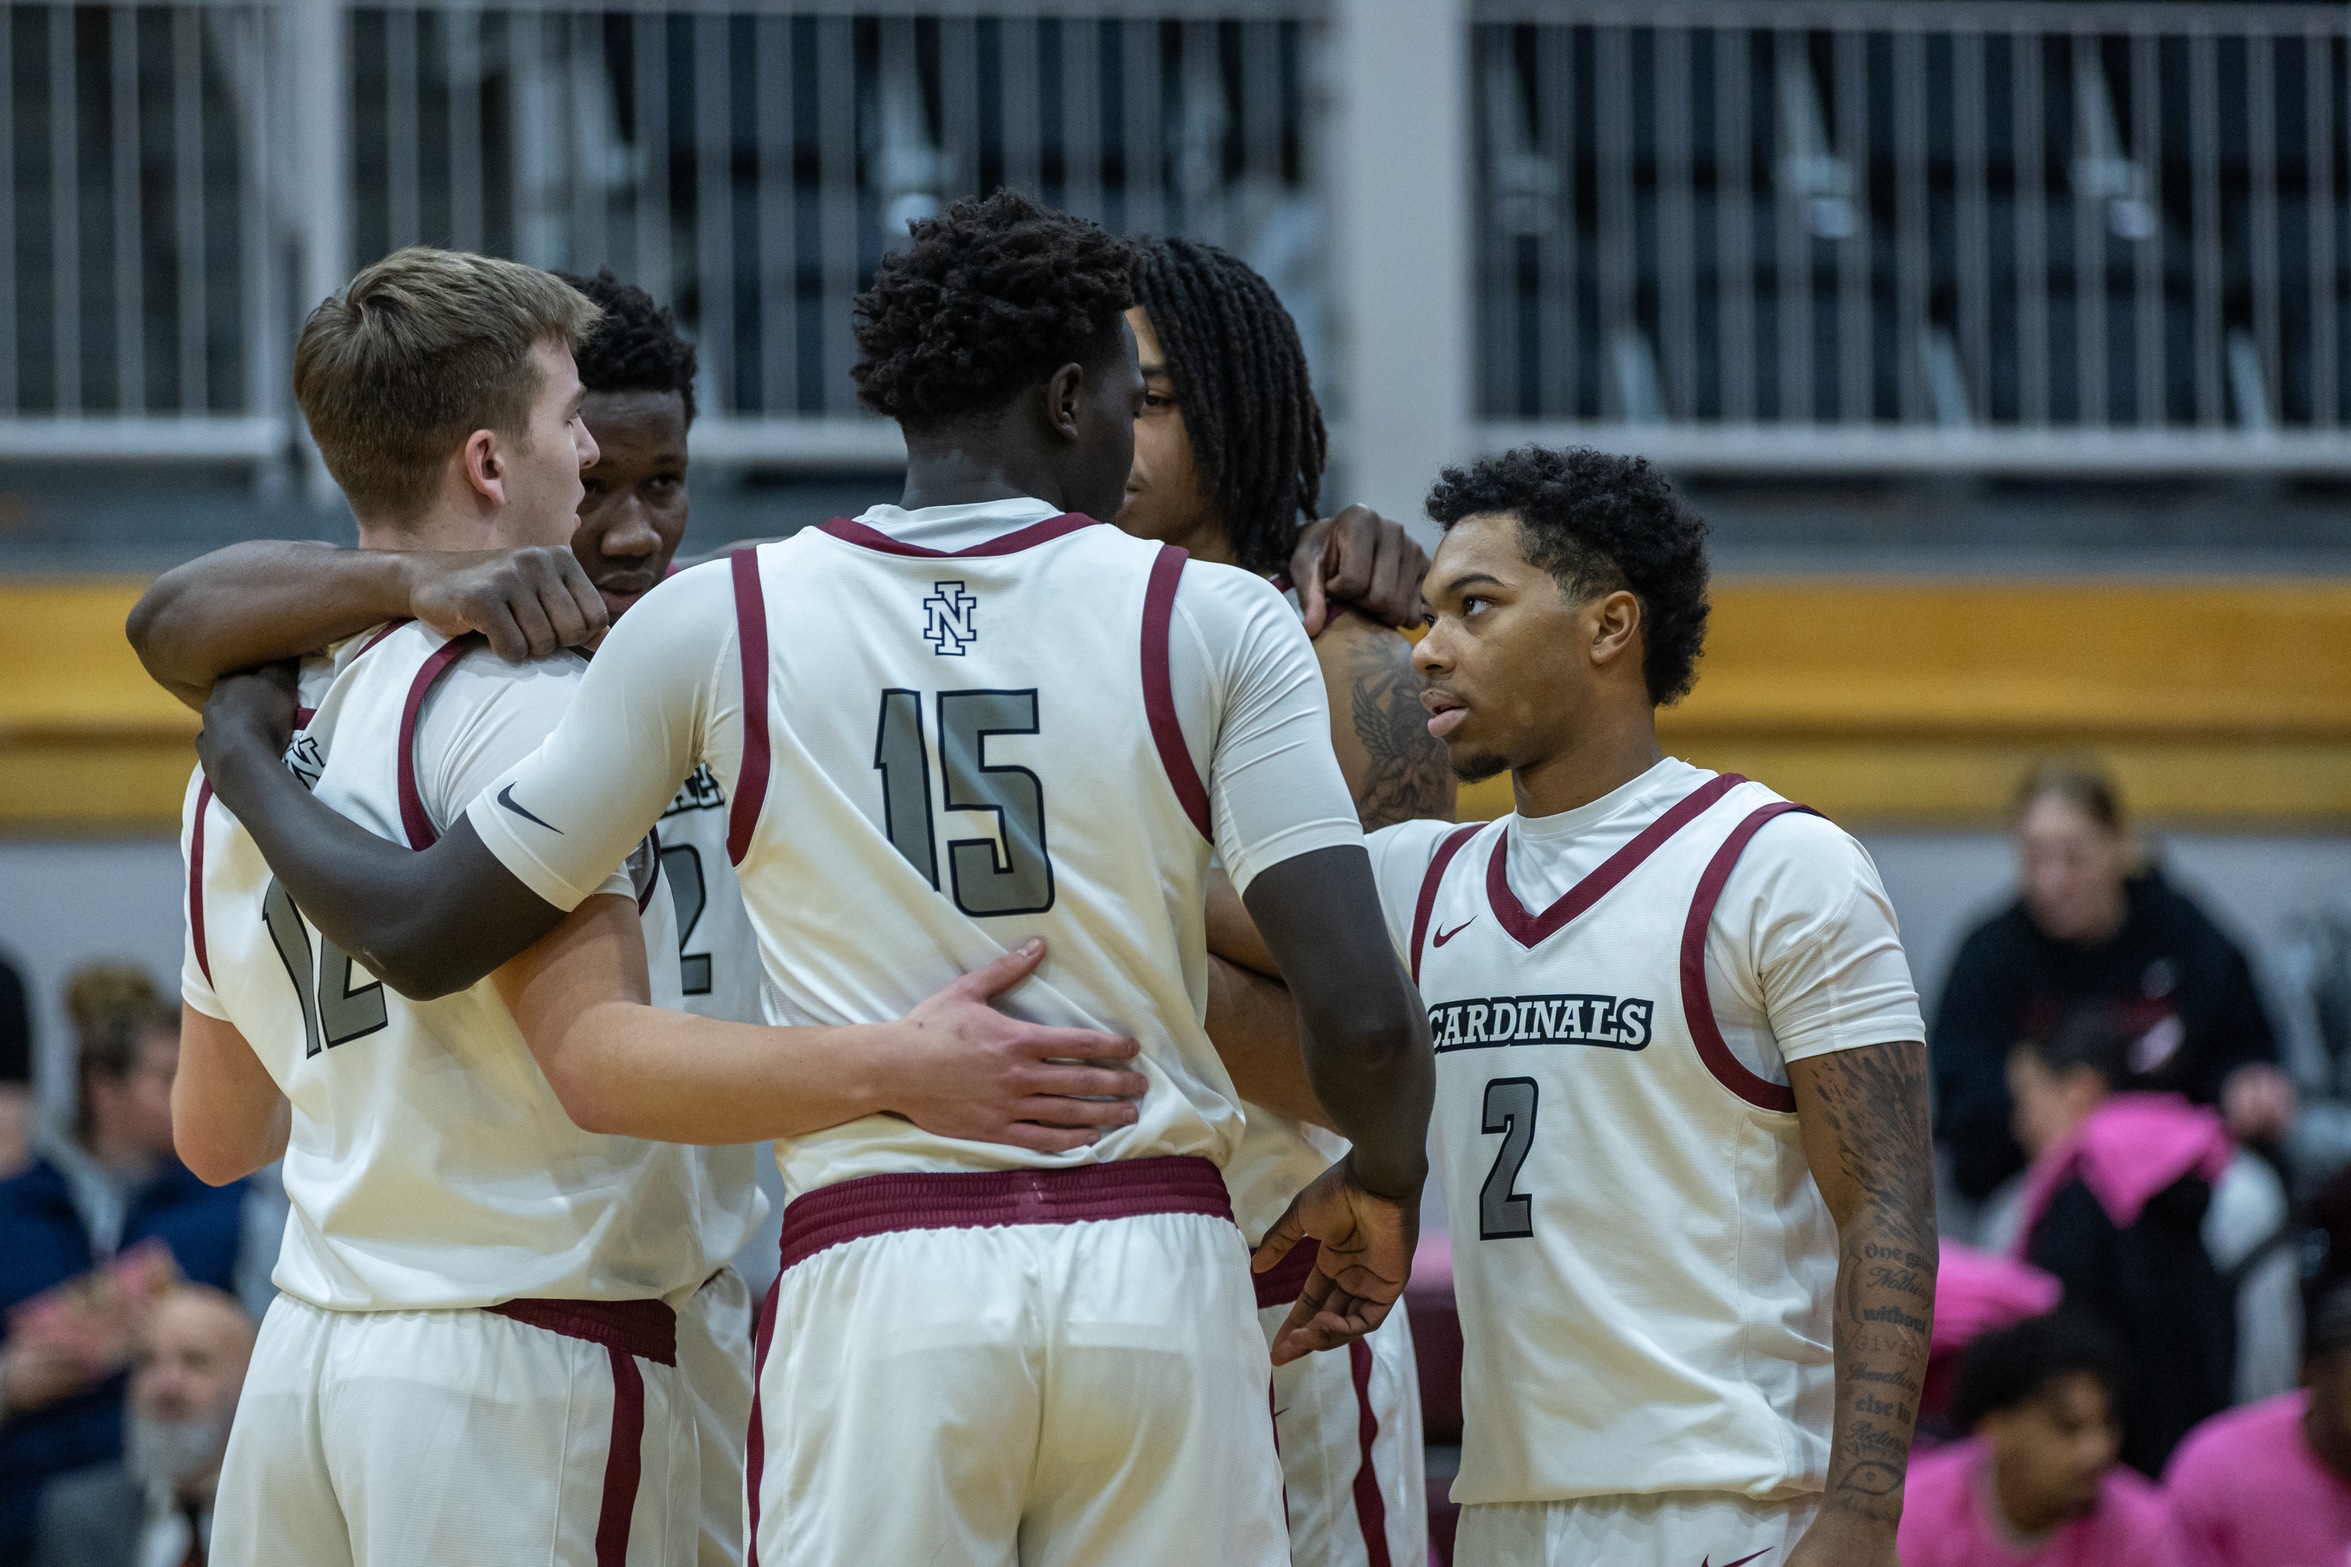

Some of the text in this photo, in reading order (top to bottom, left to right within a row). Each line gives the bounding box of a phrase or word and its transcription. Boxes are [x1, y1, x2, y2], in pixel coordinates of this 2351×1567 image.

[873, 687, 1056, 918] 15
[1429, 994, 1654, 1055] CARDINALS
[1479, 1076, 1539, 1241] 2
[1864, 1242, 1902, 1260] One
[1862, 1305, 1926, 1335] without
